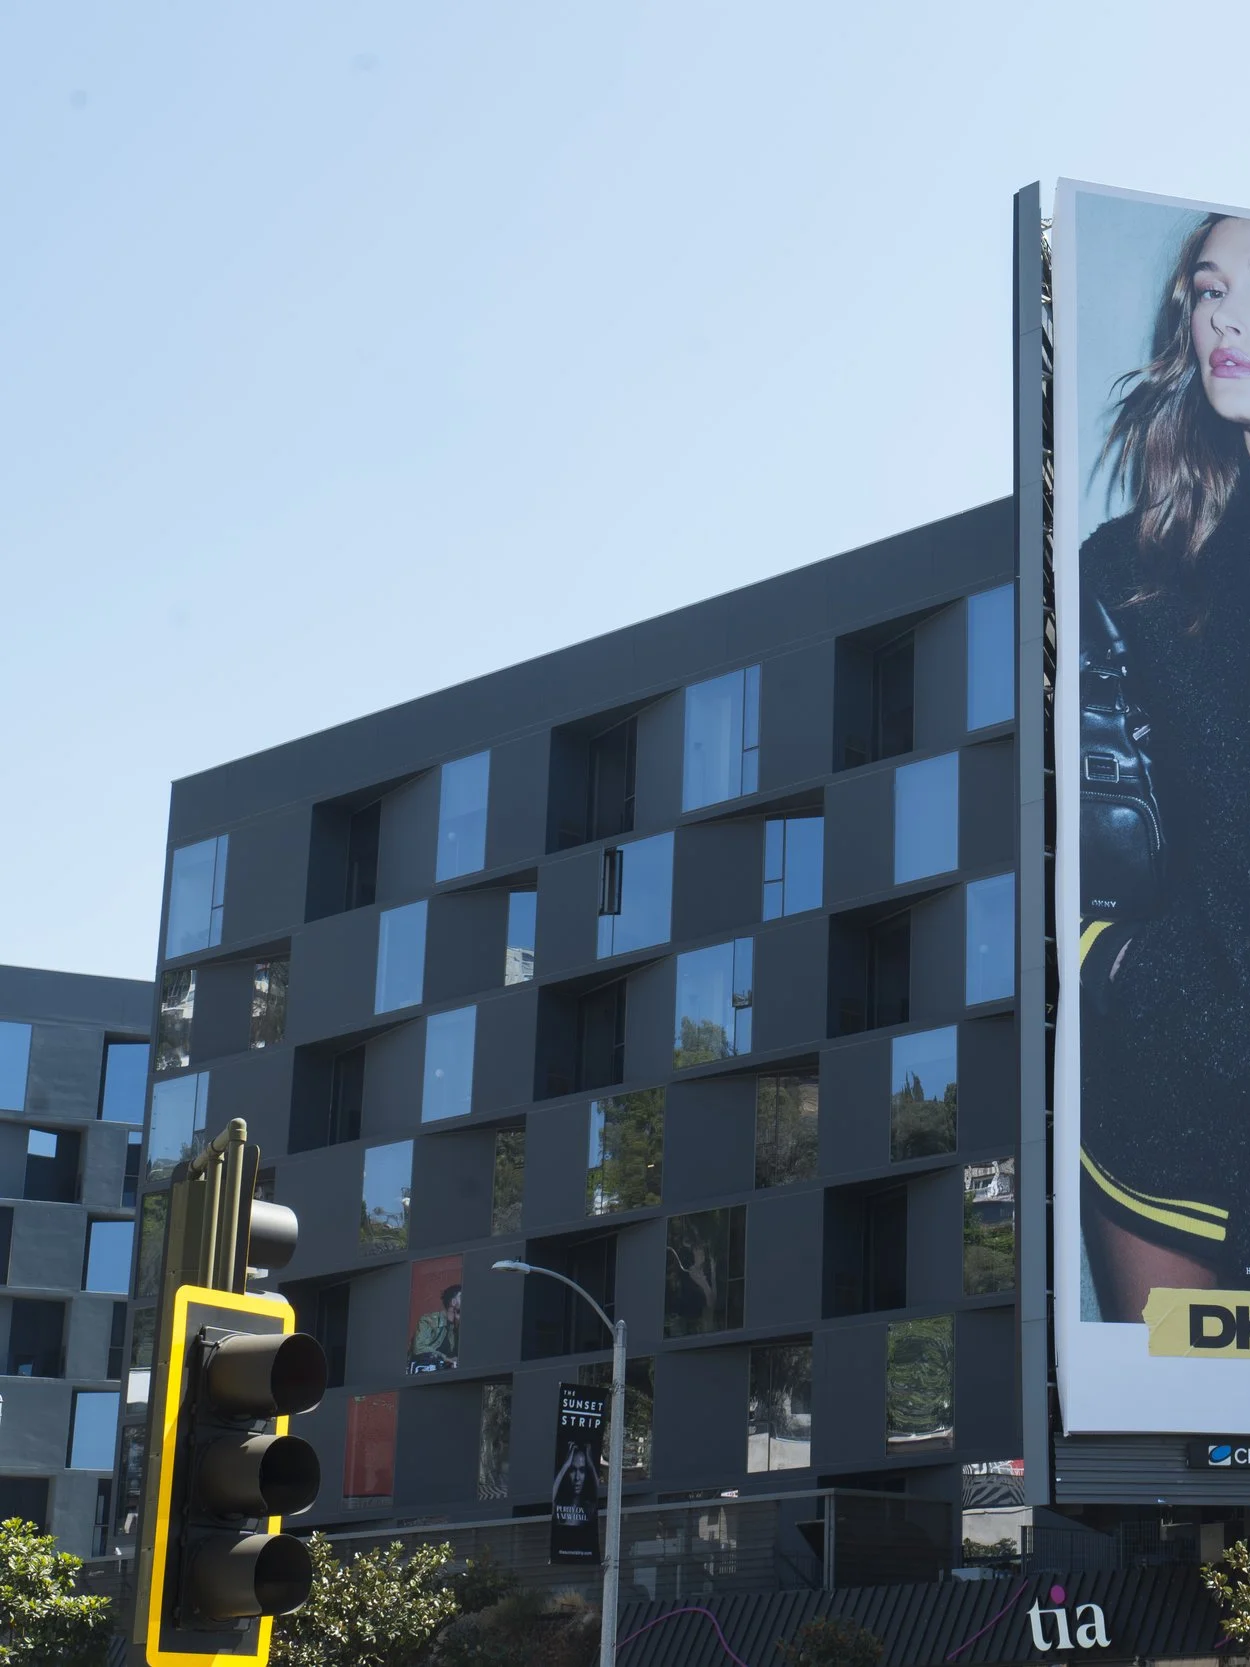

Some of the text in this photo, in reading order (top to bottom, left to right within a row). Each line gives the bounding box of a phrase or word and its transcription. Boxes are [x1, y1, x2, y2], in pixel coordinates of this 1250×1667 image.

[563, 1398, 604, 1412] SUNSET
[561, 1415, 601, 1429] STRIP
[1026, 1584, 1112, 1651] tia
